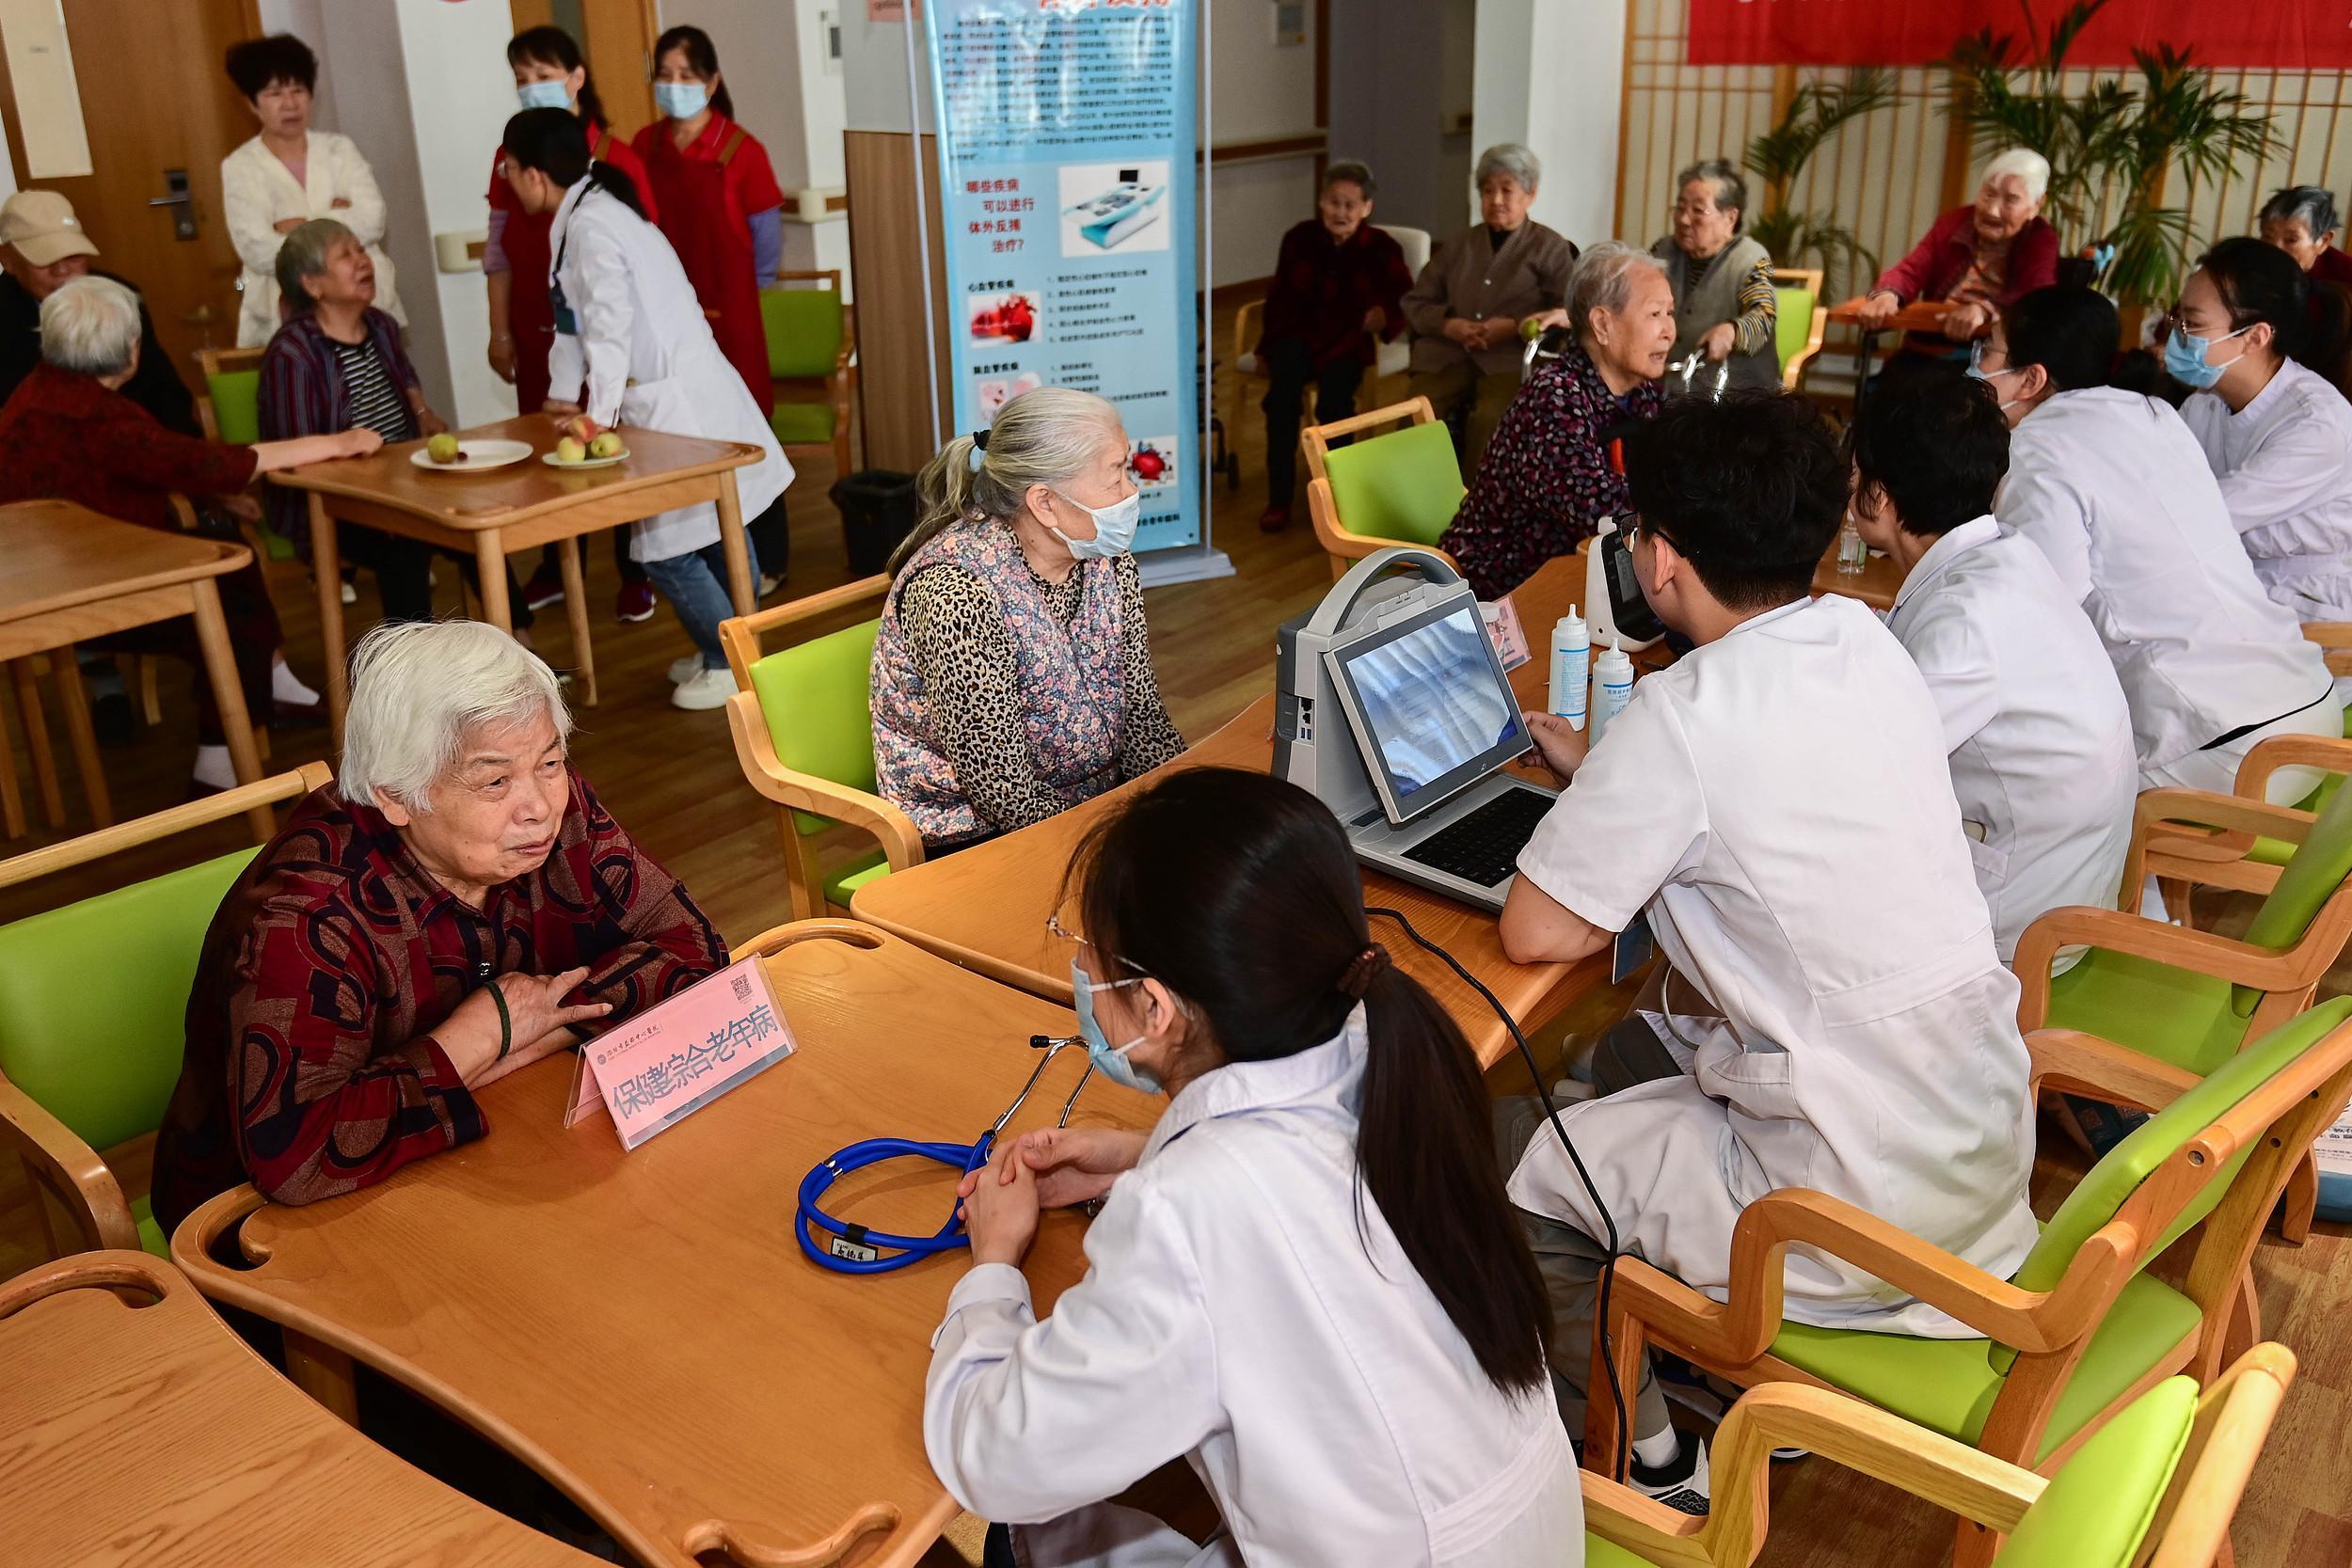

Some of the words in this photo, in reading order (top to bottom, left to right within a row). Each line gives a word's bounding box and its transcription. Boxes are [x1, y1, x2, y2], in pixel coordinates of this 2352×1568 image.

[965, 178, 1020, 194] 哪些疾病
[982, 198, 1035, 213] 可以进行
[612, 1004, 779, 1119] 保健综合老年病
